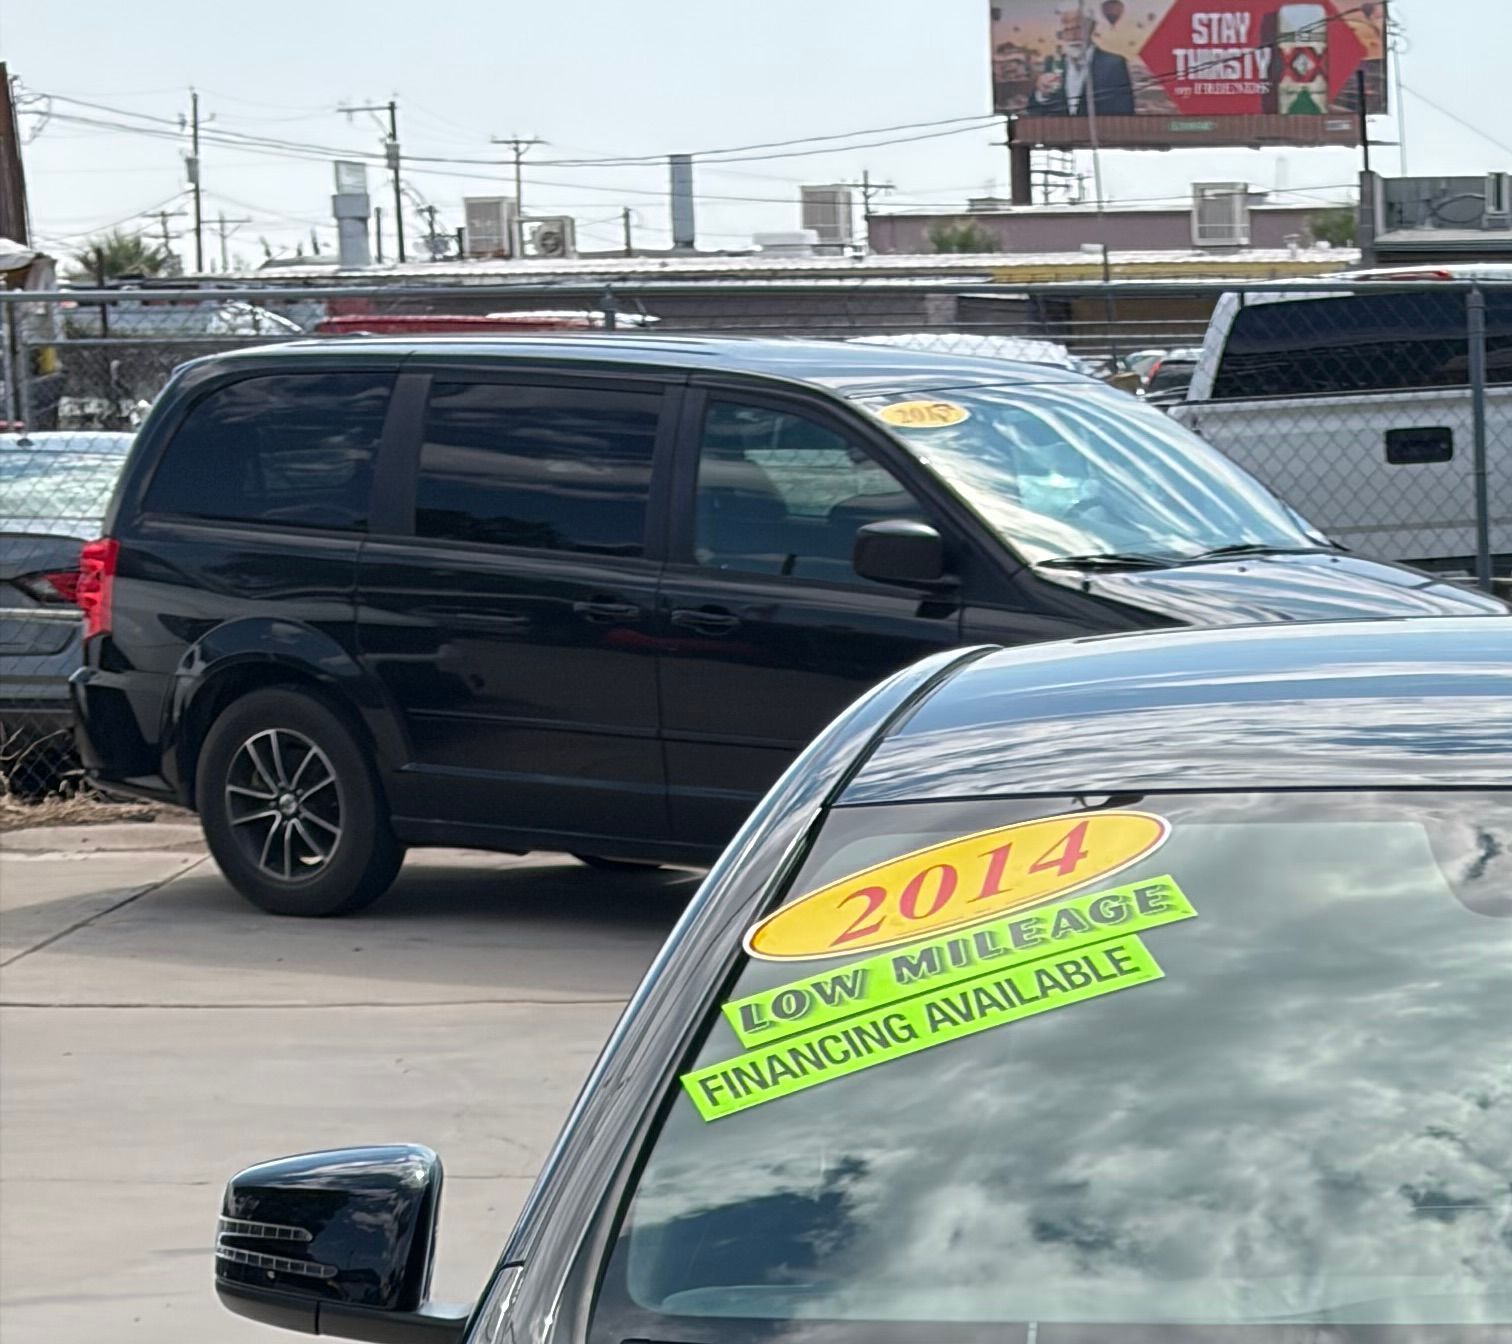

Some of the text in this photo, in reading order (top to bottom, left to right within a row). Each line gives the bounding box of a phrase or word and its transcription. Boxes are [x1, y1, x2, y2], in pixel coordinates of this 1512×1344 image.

[1191, 12, 1250, 44] STAY
[828, 820, 1091, 947] 2014
[698, 944, 1142, 1107] FINANCING AVAILABLE
[739, 883, 1175, 1036] LOW MILEAGE
